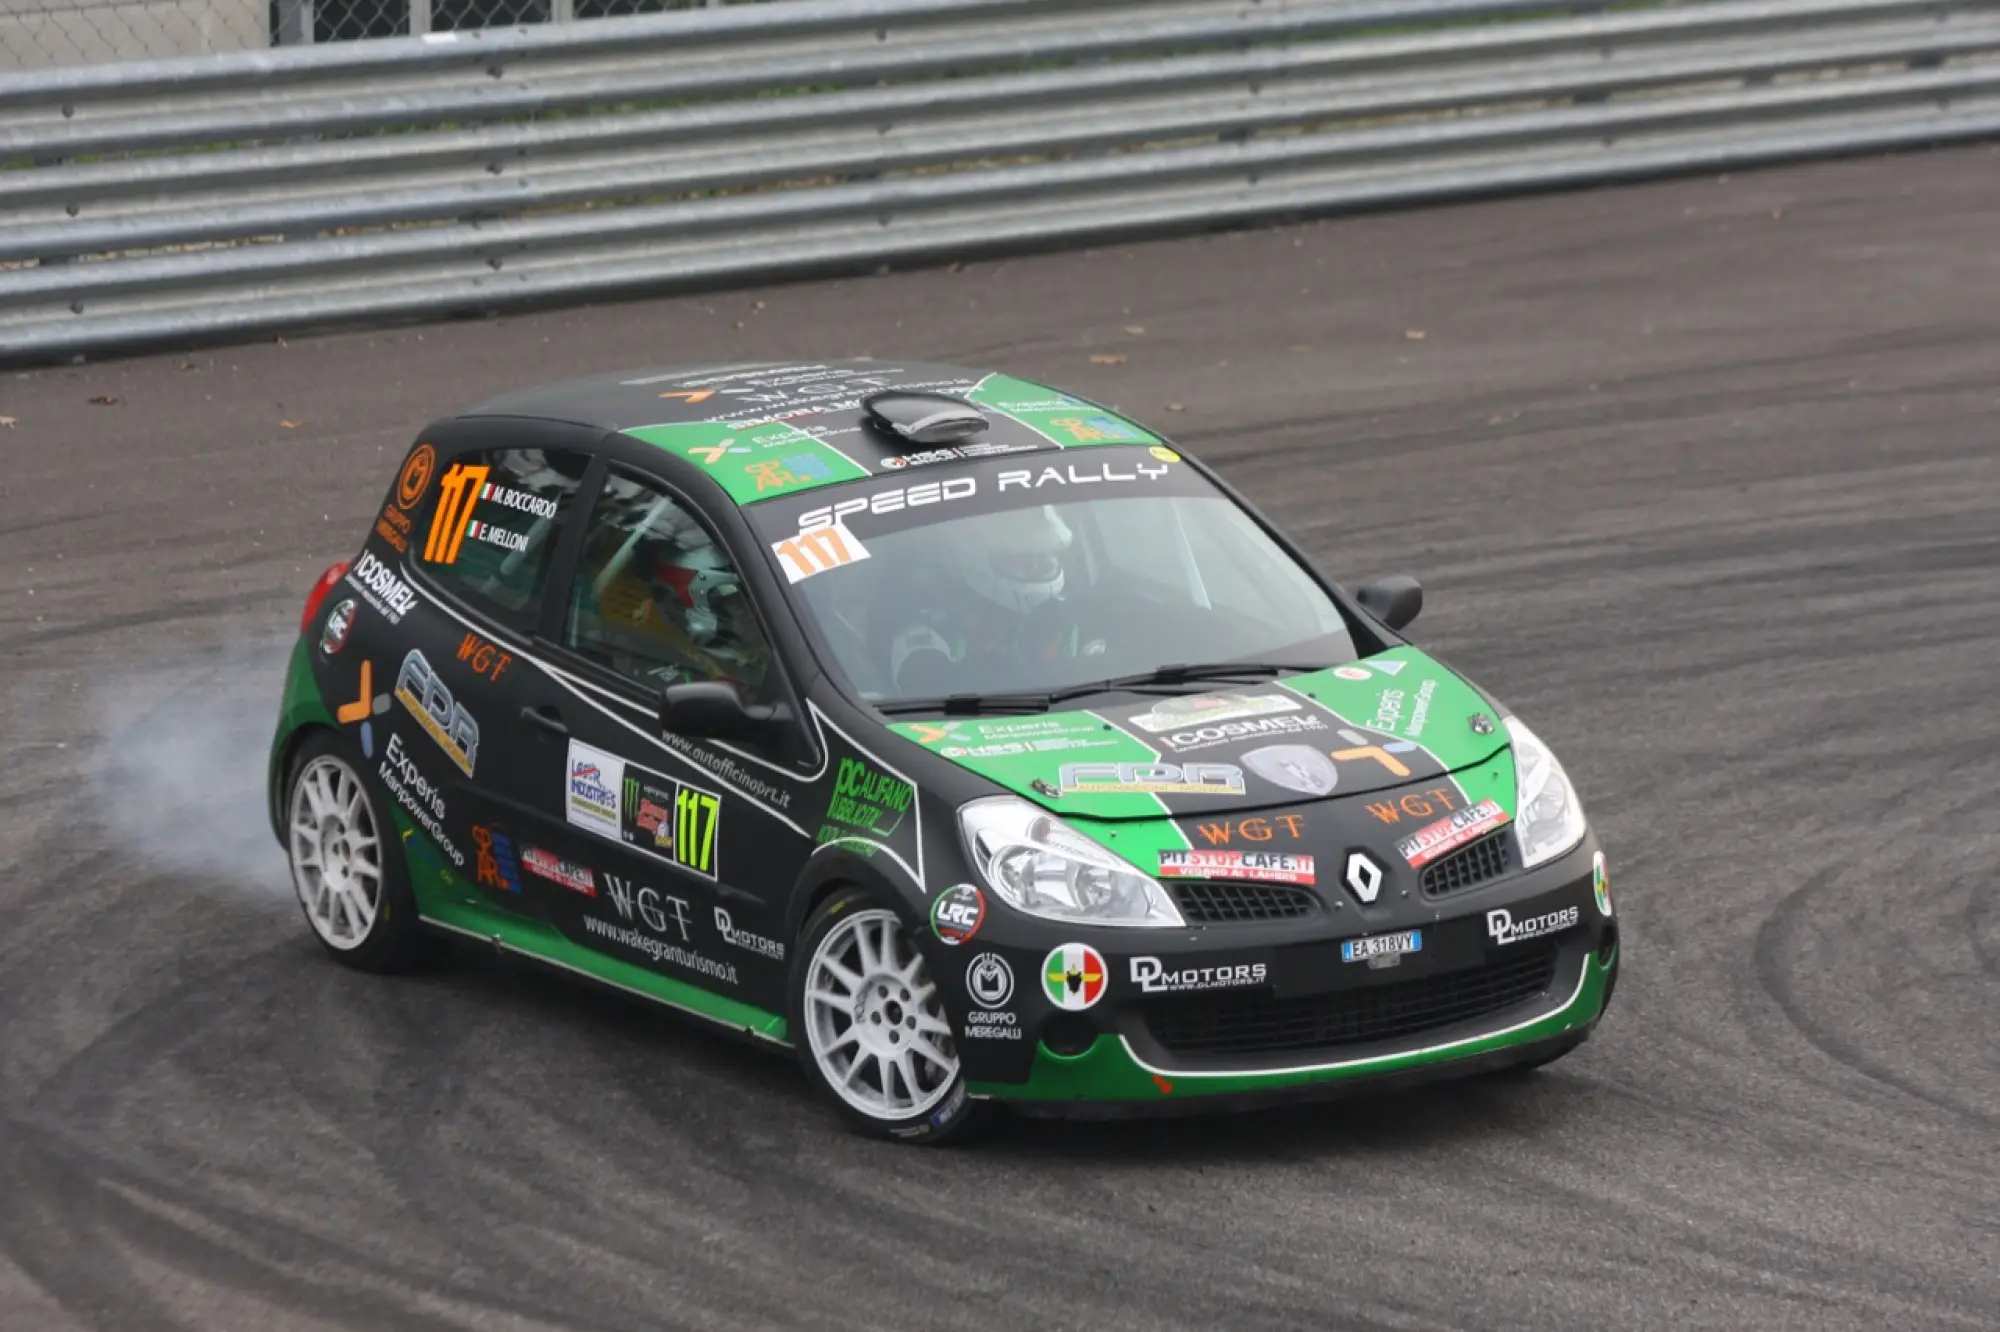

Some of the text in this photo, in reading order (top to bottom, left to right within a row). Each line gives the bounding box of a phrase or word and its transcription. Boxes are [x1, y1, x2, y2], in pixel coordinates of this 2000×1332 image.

[424, 463, 490, 564] 117
[798, 462, 1168, 526] SPEED RALLY
[778, 528, 852, 576] 117
[456, 632, 512, 681] WGT
[386, 732, 445, 820] Experis
[379, 761, 465, 867] ManpowerGroup
[677, 788, 719, 872] 117
[1197, 815, 1308, 845] WGT
[1366, 788, 1457, 824] WGT
[1159, 851, 1313, 872] PITSTOPCAFE.IT
[604, 872, 692, 942] WGT
[936, 900, 979, 927] LRC
[1510, 905, 1579, 936] MOTORS
[583, 914, 739, 986] www.wakegranturismo.it
[1161, 963, 1267, 985] MOTORS
[964, 1025, 1022, 1040] MEREGALLI
[967, 1010, 1017, 1025] GRUPPO
